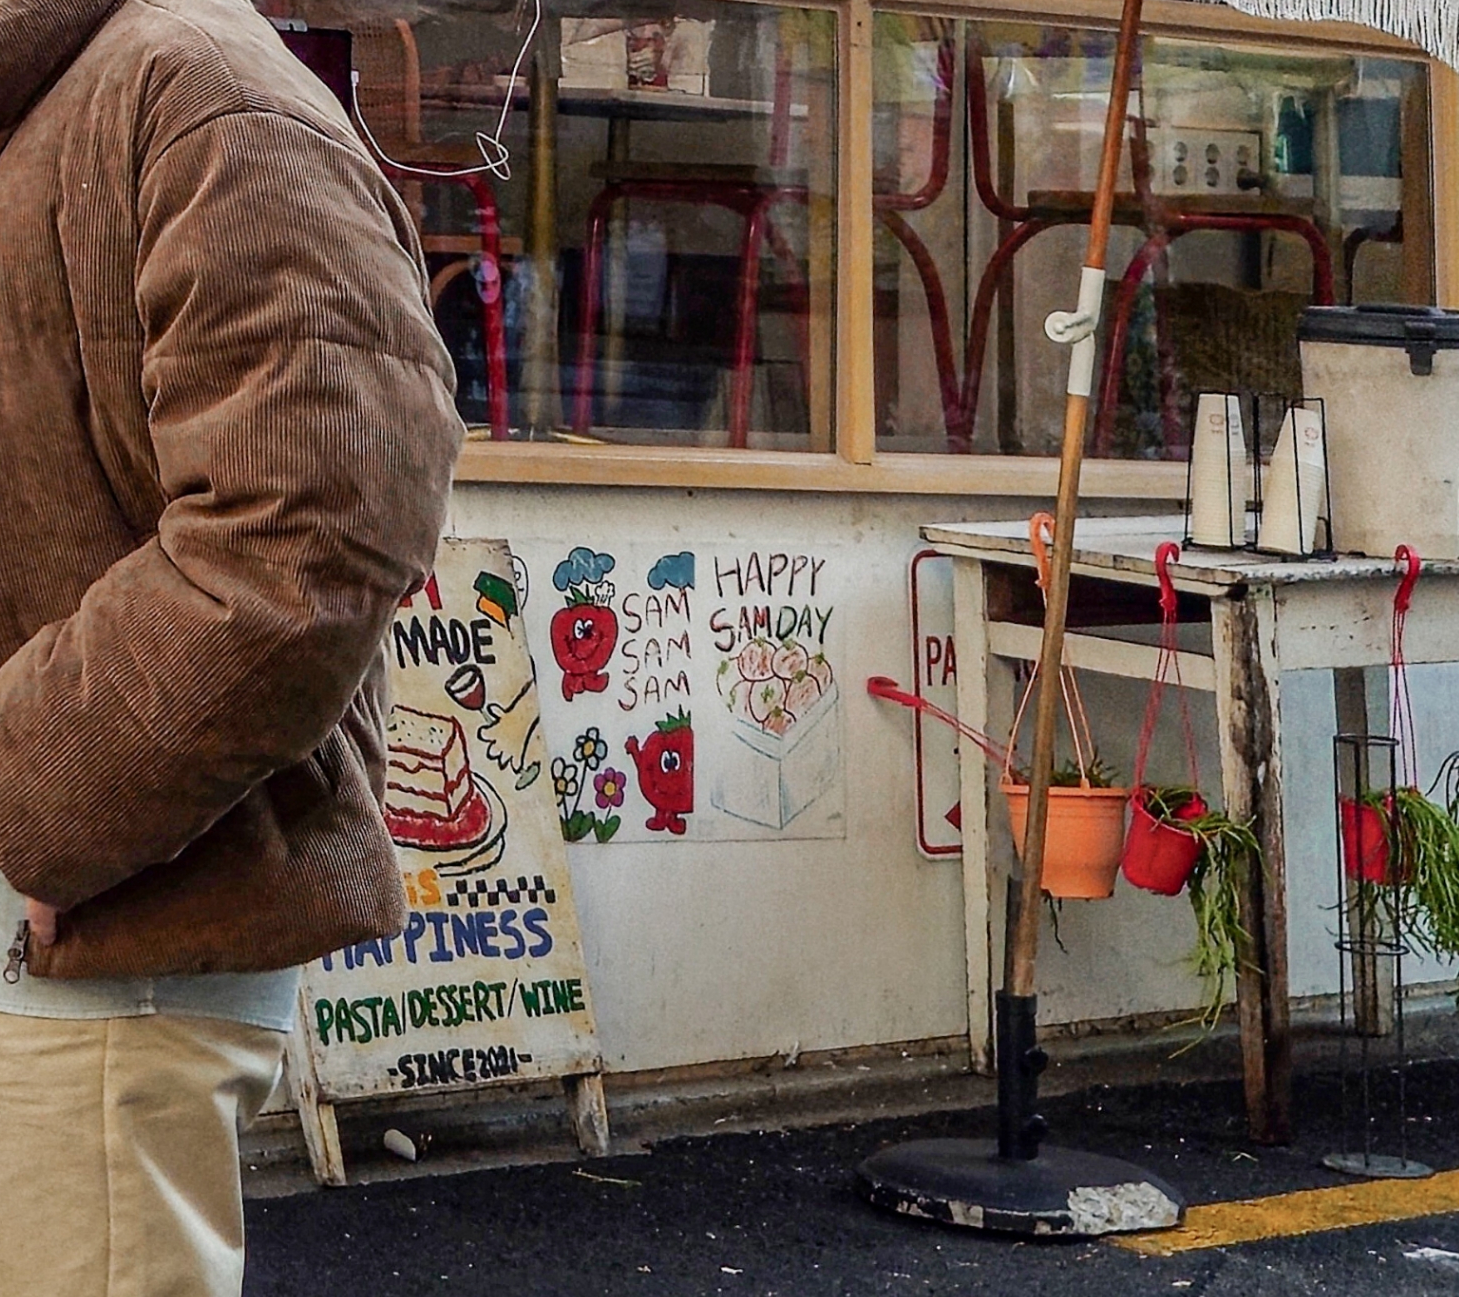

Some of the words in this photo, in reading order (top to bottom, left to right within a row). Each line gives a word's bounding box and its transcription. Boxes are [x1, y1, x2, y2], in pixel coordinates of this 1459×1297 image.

[714, 551, 826, 598] HAPPY
[622, 590, 691, 633] SAM
[393, 615, 496, 669] MADE
[622, 630, 692, 675] SAM
[926, 635, 957, 686] PA
[618, 670, 691, 711] SAM
